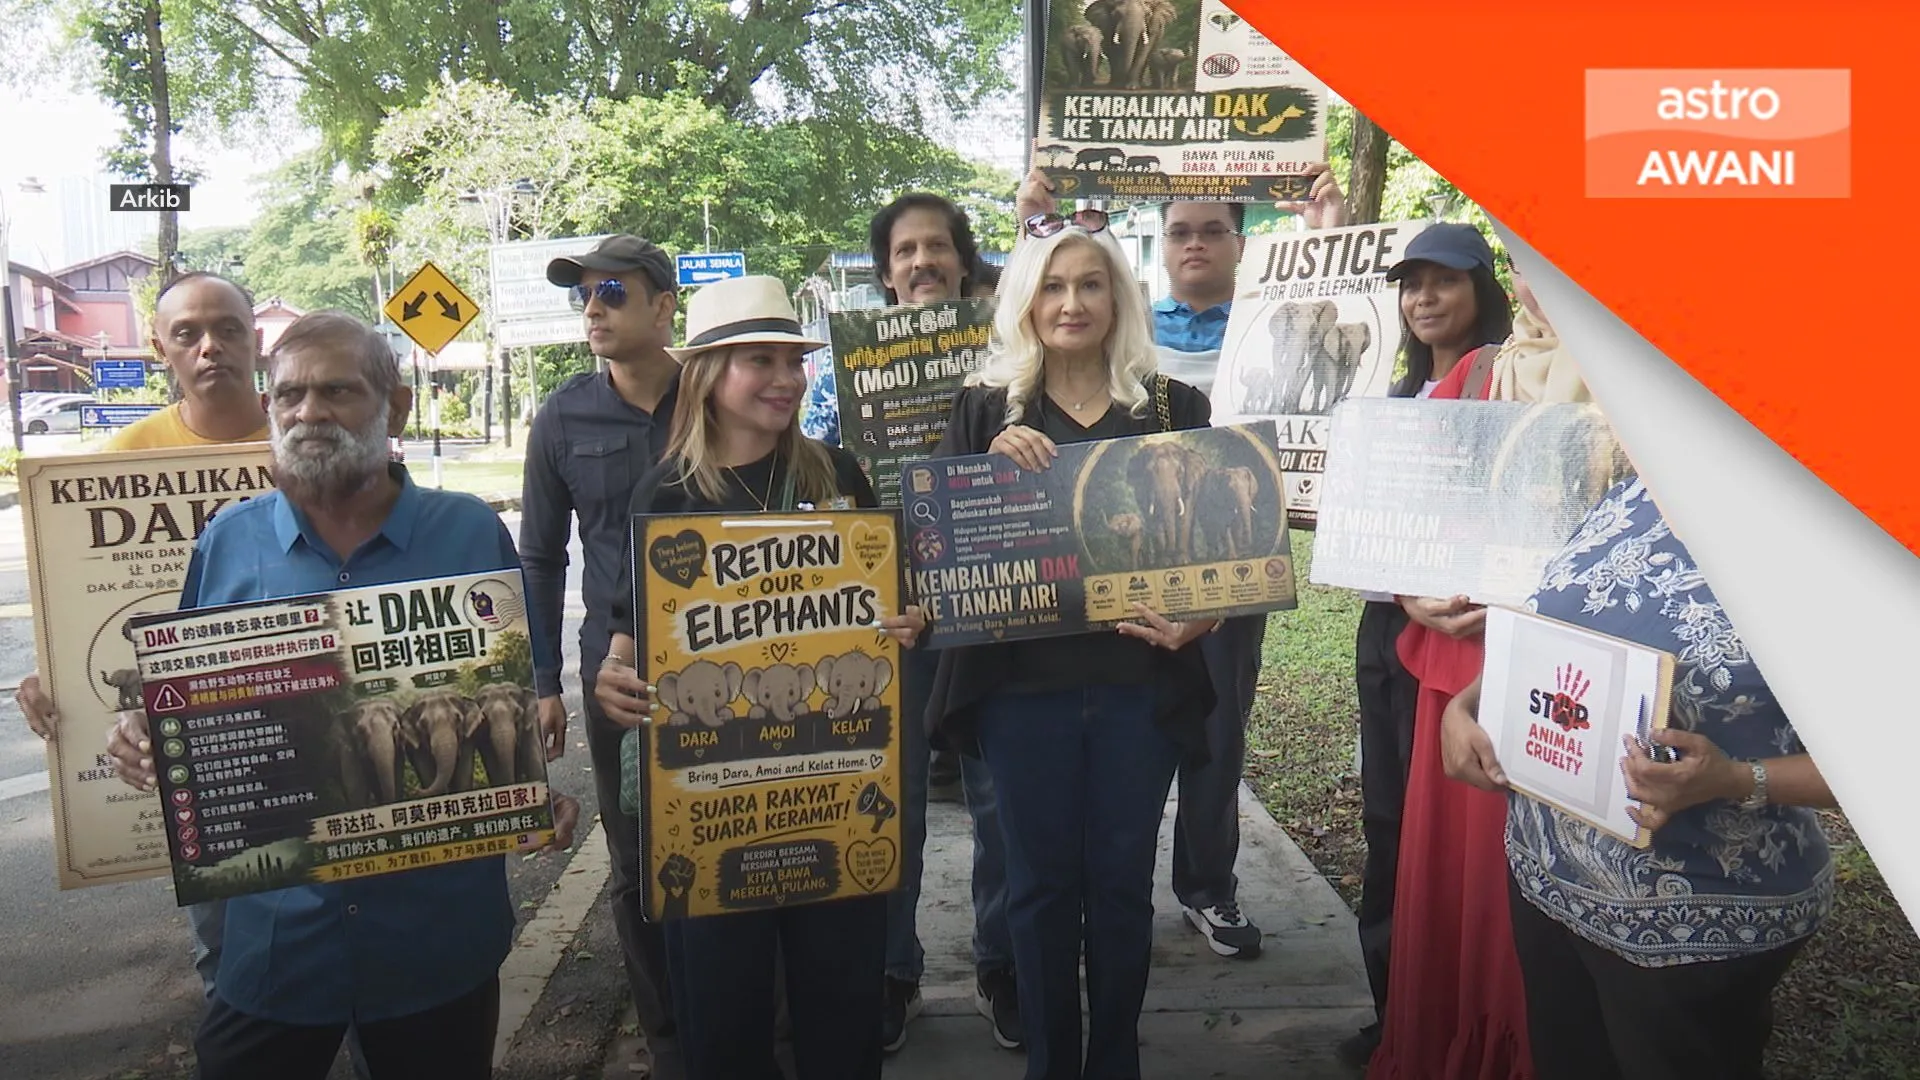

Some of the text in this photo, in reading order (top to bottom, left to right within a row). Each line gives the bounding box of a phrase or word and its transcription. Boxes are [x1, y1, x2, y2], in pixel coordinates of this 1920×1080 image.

[1064, 94, 1269, 118] KEMBALIKAN DAK
[1063, 118, 1230, 139] KE TANAH AIR!
[1182, 150, 1275, 161] BAWA PULANG
[1225, 162, 1257, 173] AMOI
[1262, 162, 1271, 172] &
[1097, 176, 1135, 186] GAJAH
[1168, 176, 1220, 186] WARISAN
[679, 257, 742, 270] JALAN SEHALA
[1259, 227, 1398, 284] JUSTICE
[1263, 277, 1385, 300] FOR OUR ELEPHANT!
[854, 361, 918, 398] (MoU)
[1277, 419, 1321, 445] AK
[947, 463, 992, 476] Di Manakah
[49, 465, 277, 504] KEMBALIKAN
[971, 475, 994, 487] untuk
[950, 495, 1002, 510] Bagaimanakah
[988, 506, 1002, 517] dan
[1003, 500, 1053, 514] dilaksanakan?
[112, 547, 186, 562] BRING DAK
[712, 534, 840, 586] RETURN
[129, 562, 185, 576] 让 DAK
[915, 554, 1081, 596] KEMBALIKAN DAK
[86, 582, 117, 595] DAK
[760, 573, 804, 595] OUR
[345, 584, 461, 636] 让 DAK
[918, 583, 1058, 621] KE TANAH AIR!
[686, 585, 876, 652] ELEPHANTS
[957, 621, 984, 633] Pulang
[1008, 616, 1027, 627] Amoi
[1029, 614, 1037, 625] &
[144, 626, 180, 648] DAK
[351, 628, 487, 674] 回到祖国！
[759, 724, 795, 741] AMOI
[832, 718, 872, 736] KELAT
[680, 731, 719, 748] DARA
[1529, 723, 1584, 757] ANIMAL
[1525, 740, 1583, 775] CRUELTY
[688, 756, 868, 784] Bring Dara, Amoi and Kelat Home.
[689, 782, 841, 823] SUARA RAKYAT
[692, 798, 851, 847] SUARA KERAMAT!
[741, 859, 780, 872] BERSUARA
[743, 848, 777, 861] BERDIRI
[746, 866, 811, 885] KITA BAWA
[730, 877, 830, 900] MEREKA PULANG.
